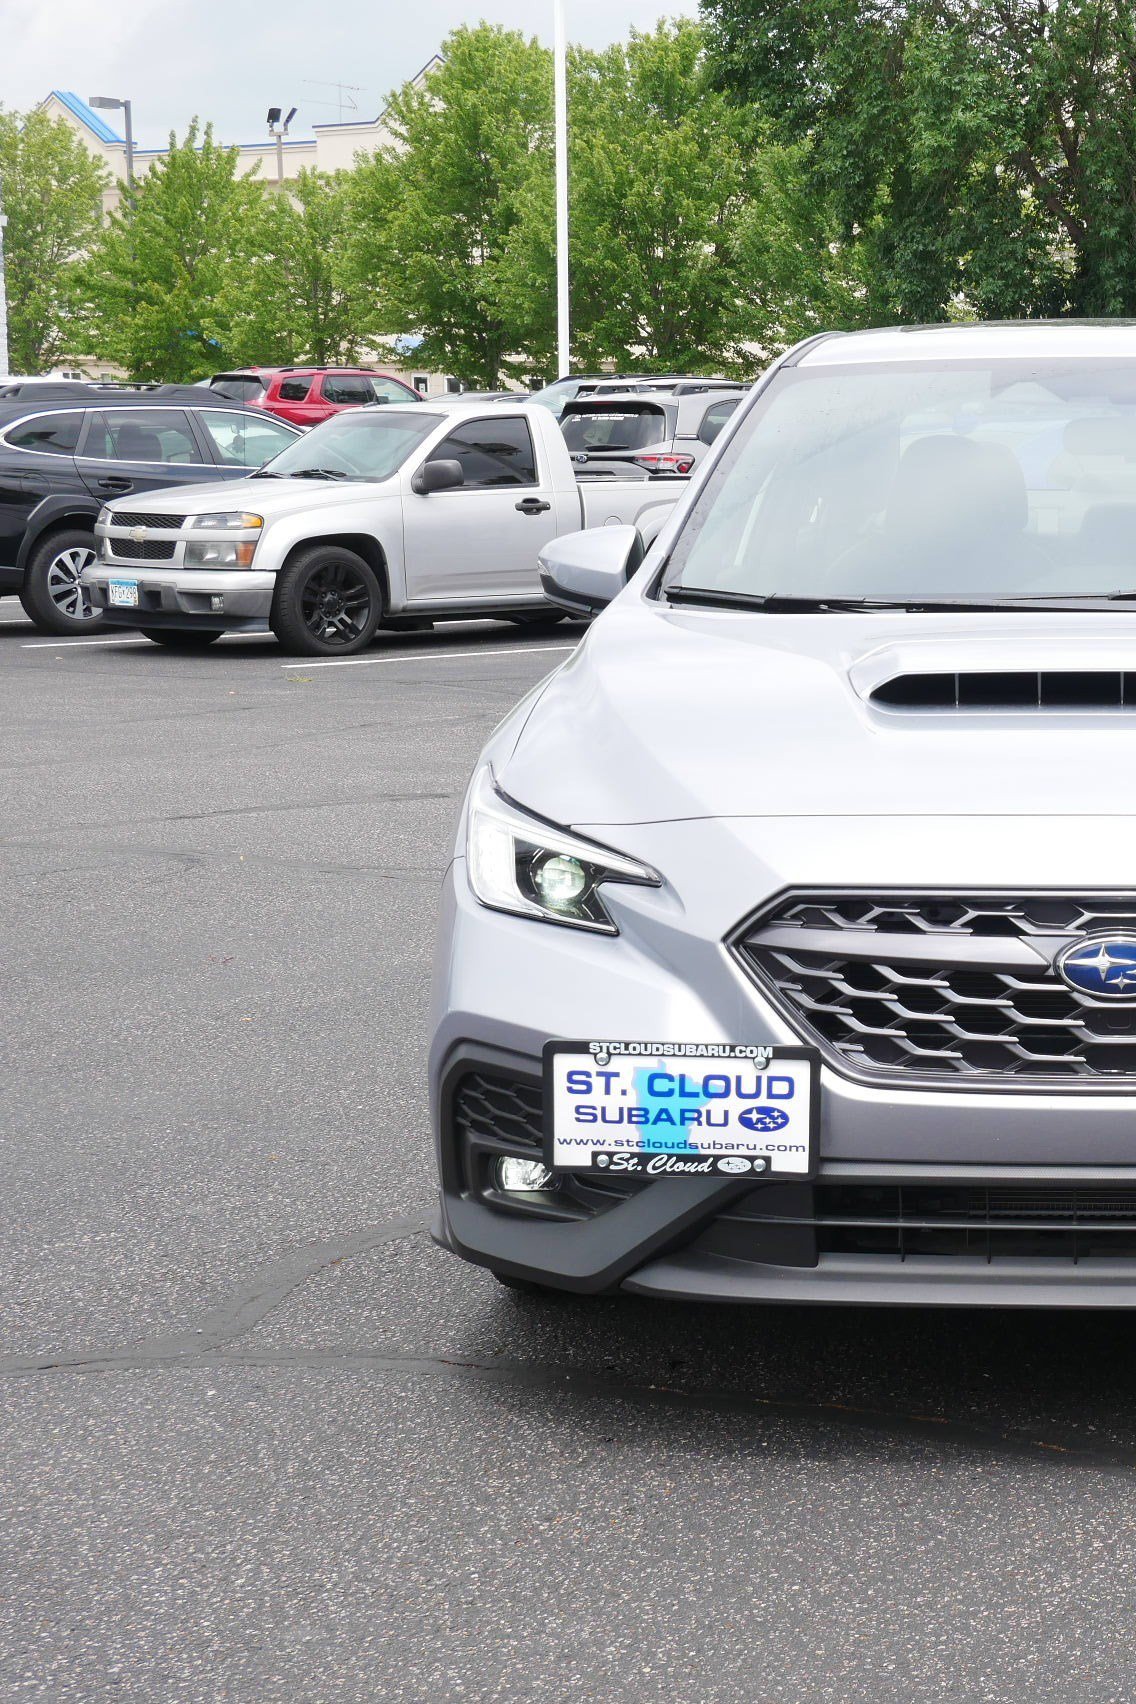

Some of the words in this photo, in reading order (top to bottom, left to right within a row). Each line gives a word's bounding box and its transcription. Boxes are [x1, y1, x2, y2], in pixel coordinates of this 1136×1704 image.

[589, 1042, 773, 1058] STCLOUDSUBARU.COM
[566, 1070, 628, 1096] ST.
[647, 1072, 795, 1100] CLOUD
[574, 1104, 729, 1128] SUBARU
[557, 1137, 806, 1153] www.stcloudsubaru.com
[609, 1153, 642, 1171] St.
[646, 1154, 713, 1174] Cloud
